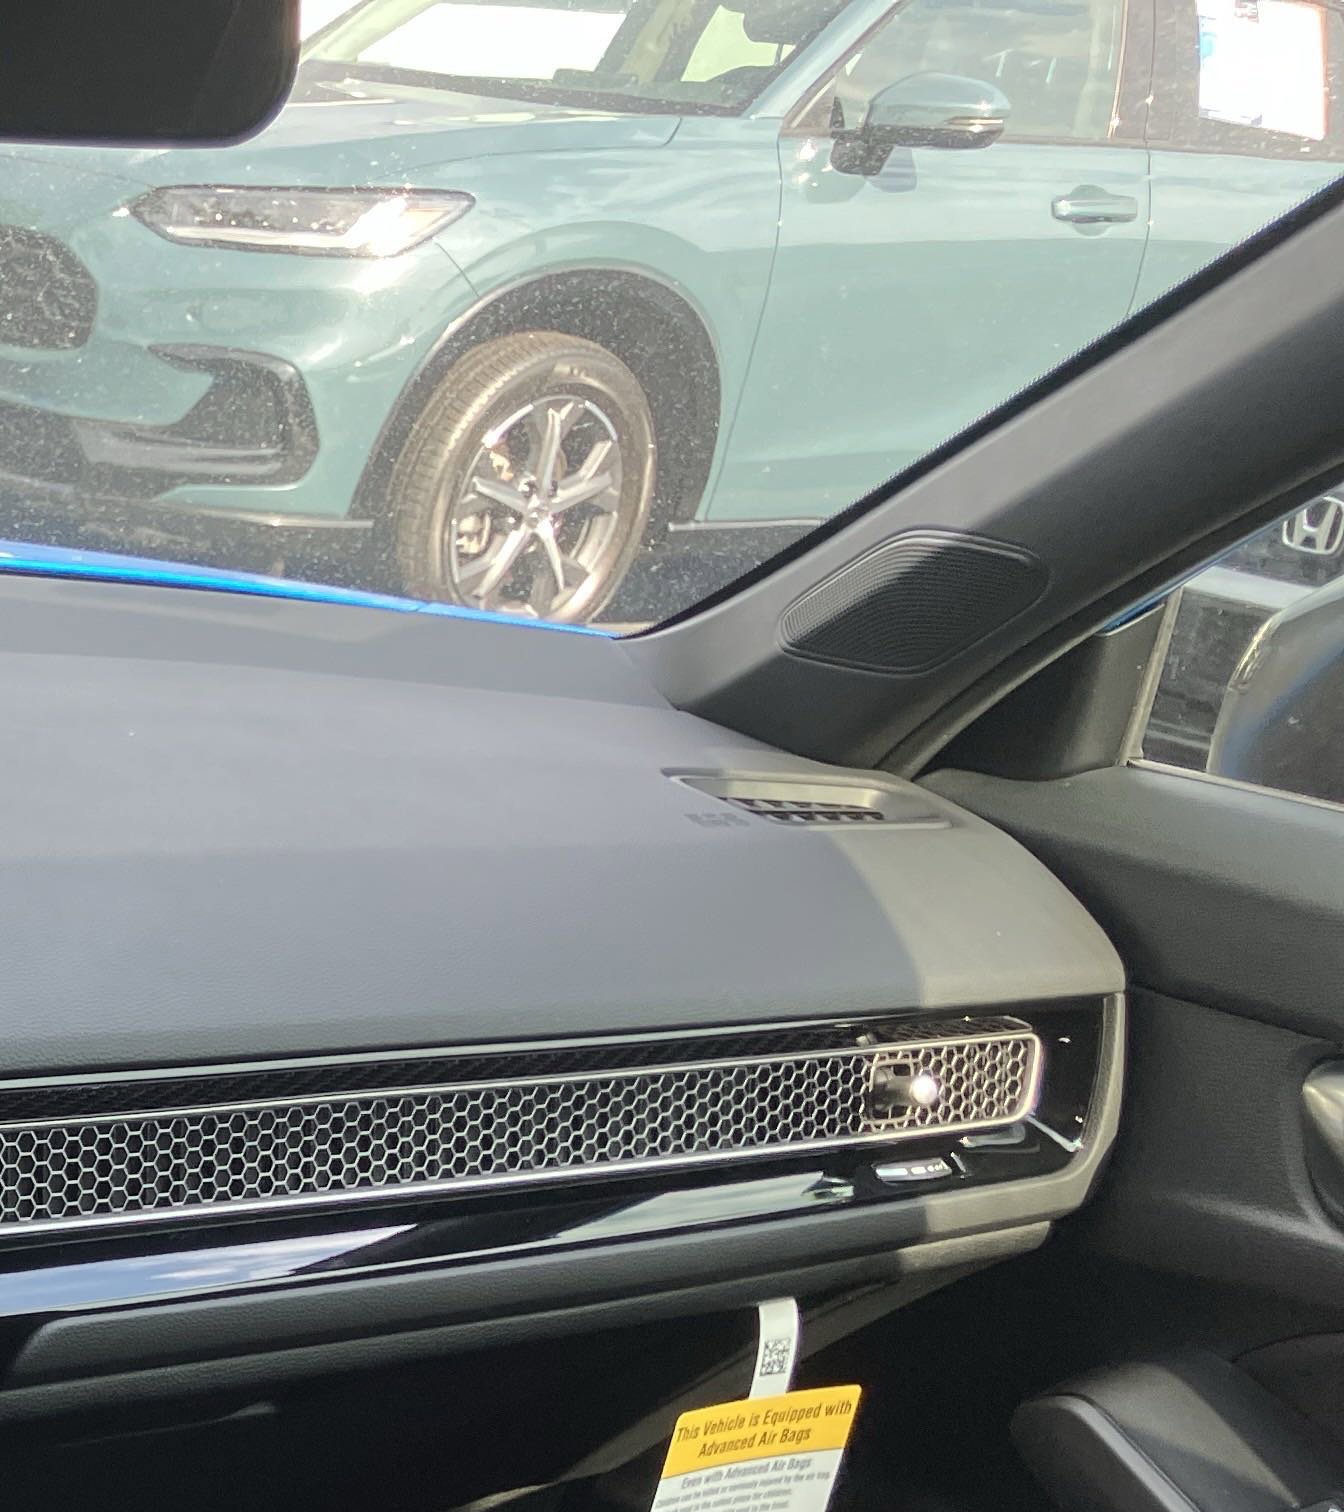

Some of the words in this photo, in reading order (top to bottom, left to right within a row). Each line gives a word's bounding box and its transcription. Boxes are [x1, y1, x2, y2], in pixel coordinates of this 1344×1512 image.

[676, 1425, 700, 1442] This
[703, 1415, 745, 1436] Vehicle
[749, 1411, 760, 1427] is
[763, 1402, 820, 1427] Equipped
[824, 1400, 852, 1417] with
[698, 1433, 755, 1458] Advanced
[759, 1430, 776, 1447] Air
[779, 1426, 811, 1444] Bags
